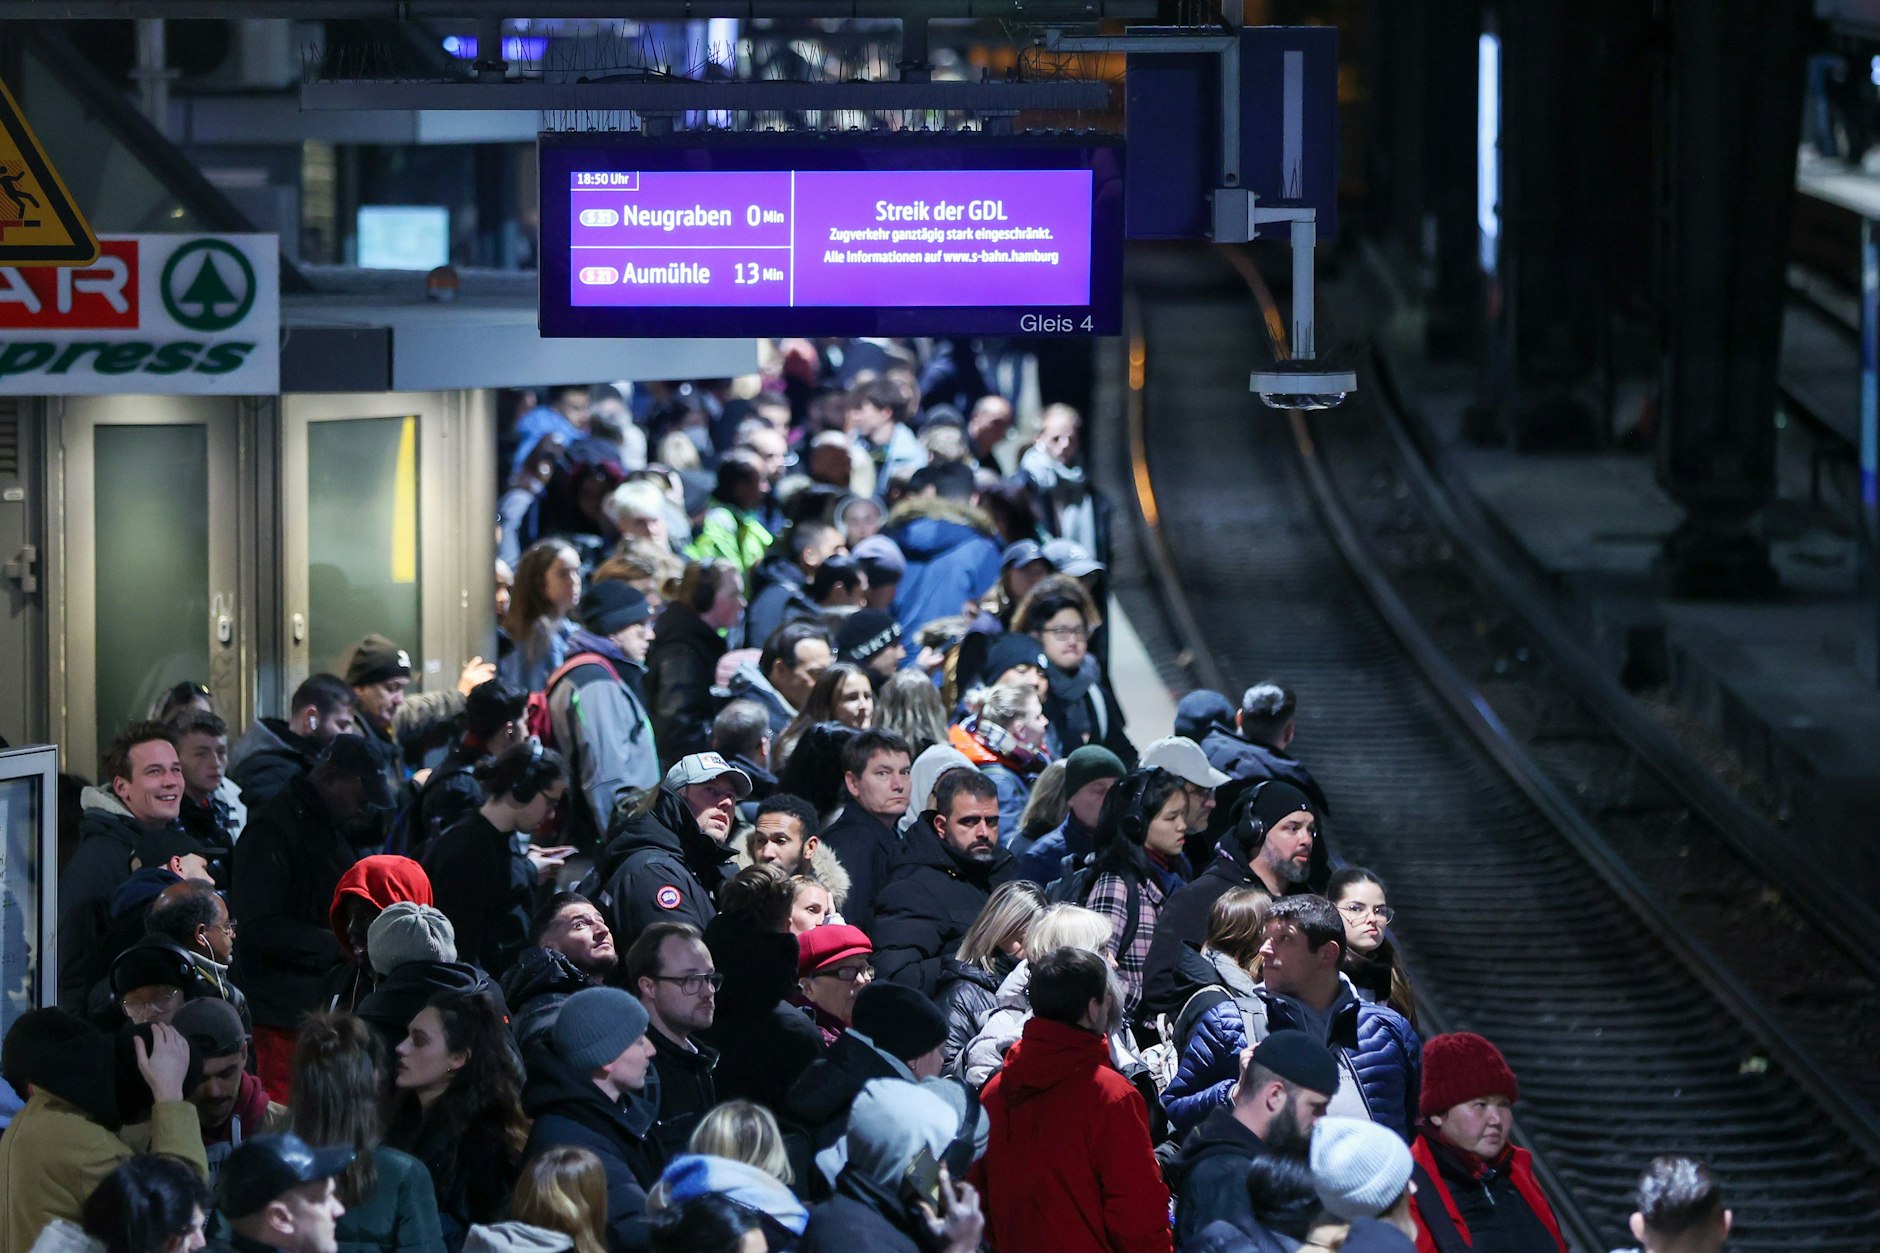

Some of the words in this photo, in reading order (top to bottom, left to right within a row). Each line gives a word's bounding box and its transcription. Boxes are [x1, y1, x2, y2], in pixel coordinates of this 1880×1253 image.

[577, 173, 609, 185] 18:50
[610, 173, 629, 185] Uhr
[623, 204, 732, 232] Neugraben
[746, 204, 761, 227] 0
[763, 210, 785, 223] Min
[875, 200, 930, 221] Streik
[933, 200, 965, 221] der
[968, 200, 1008, 221] GDL
[829, 227, 891, 243] Zugverkehr
[892, 227, 945, 243] ganztägig
[946, 227, 974, 240] stark
[975, 227, 1054, 243] eingeschränkt.
[823, 250, 845, 263] Alle
[846, 250, 923, 263] Informationen
[924, 250, 942, 263] auf
[943, 249, 1059, 265] www.s-bahn.hamburg
[622, 262, 711, 284] Aumühle
[734, 262, 760, 285] 13
[763, 267, 784, 281] Min
[1020, 314, 1074, 332] Gleis
[1080, 314, 1094, 332] 4
